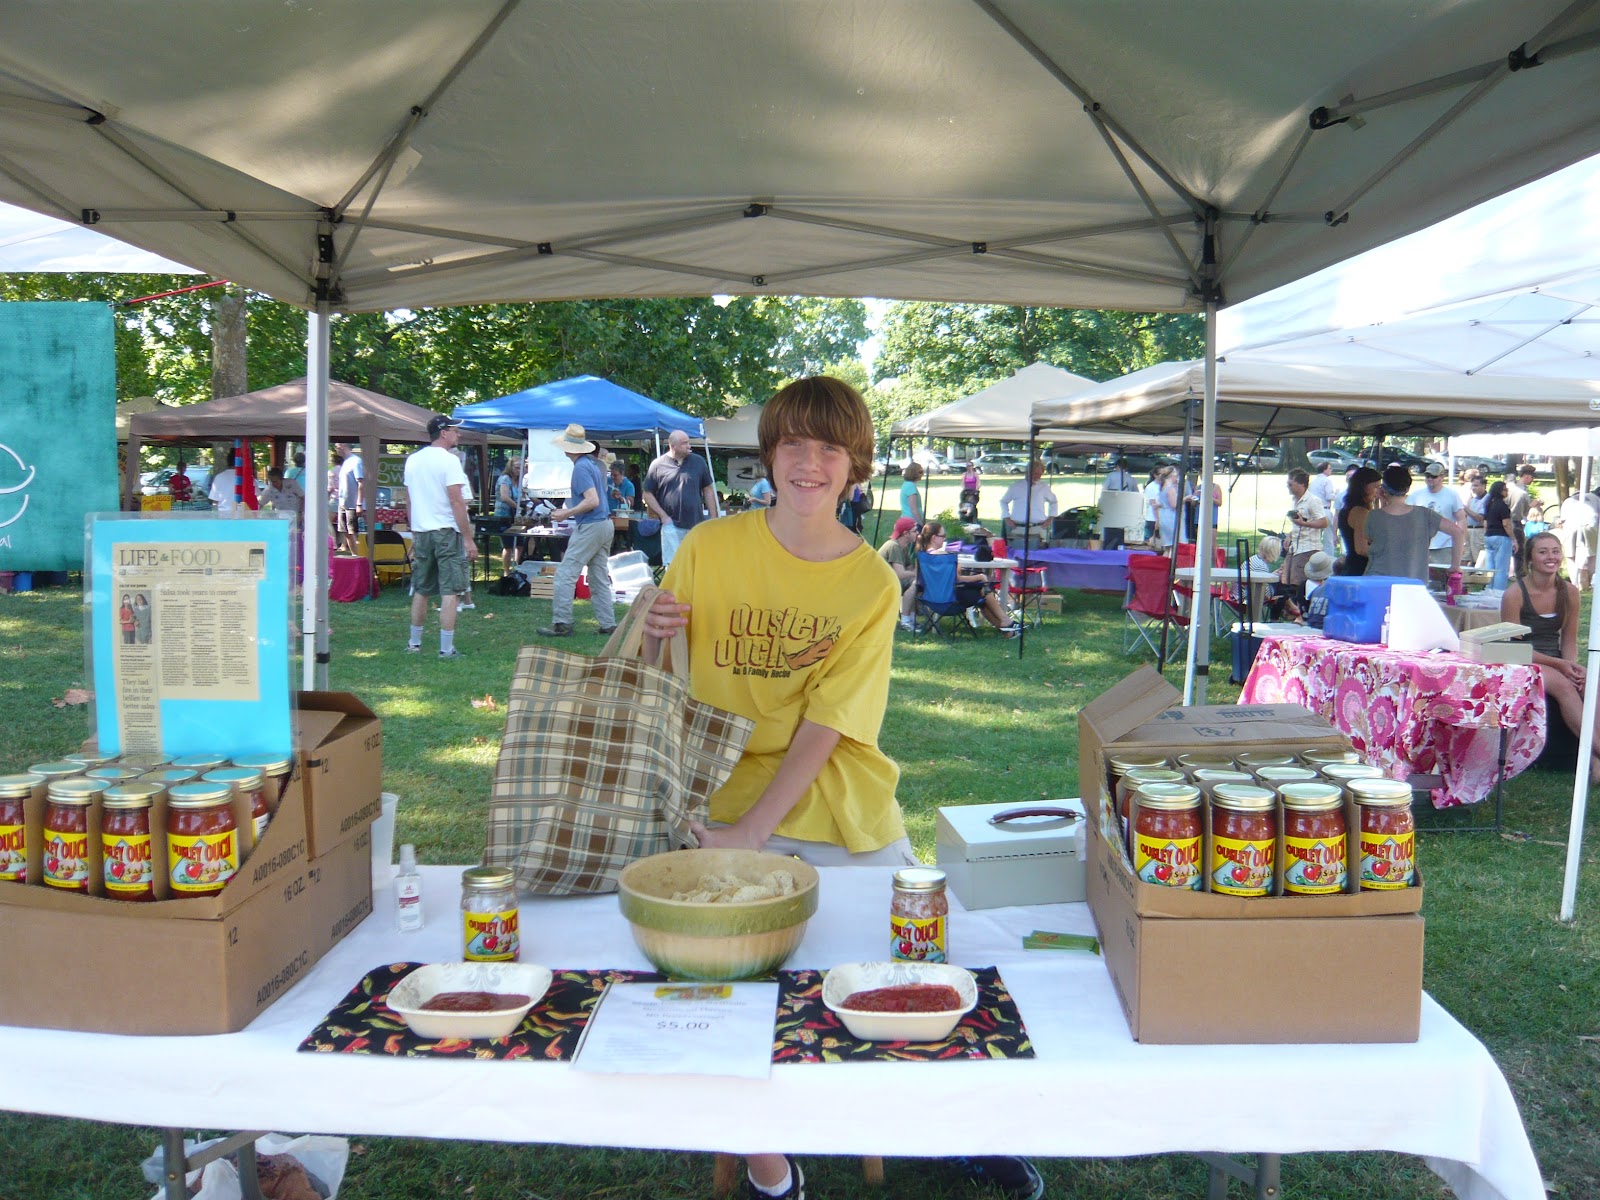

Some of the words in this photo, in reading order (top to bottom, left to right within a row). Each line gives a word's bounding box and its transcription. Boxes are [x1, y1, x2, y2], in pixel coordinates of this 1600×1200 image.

[119, 549, 159, 566] LIFE
[160, 553, 169, 561] &
[170, 549, 221, 566] FOOD
[160, 588, 176, 596] Salsa
[177, 588, 190, 596] took
[191, 589, 208, 597] years
[729, 603, 837, 643] Ousley
[748, 667, 769, 679] Family
[172, 843, 203, 863] OUSLEY
[204, 833, 231, 862] OUCH
[1140, 843, 1173, 864] OUSLEY
[1216, 844, 1252, 867] OUSLEY
[1286, 844, 1322, 864] OUSLEY
[126, 866, 152, 875] SALS
[283, 884, 292, 903] 16
[293, 876, 305, 896] OZ
[228, 926, 238, 947] 12
[656, 1020, 710, 1030] $5.00
